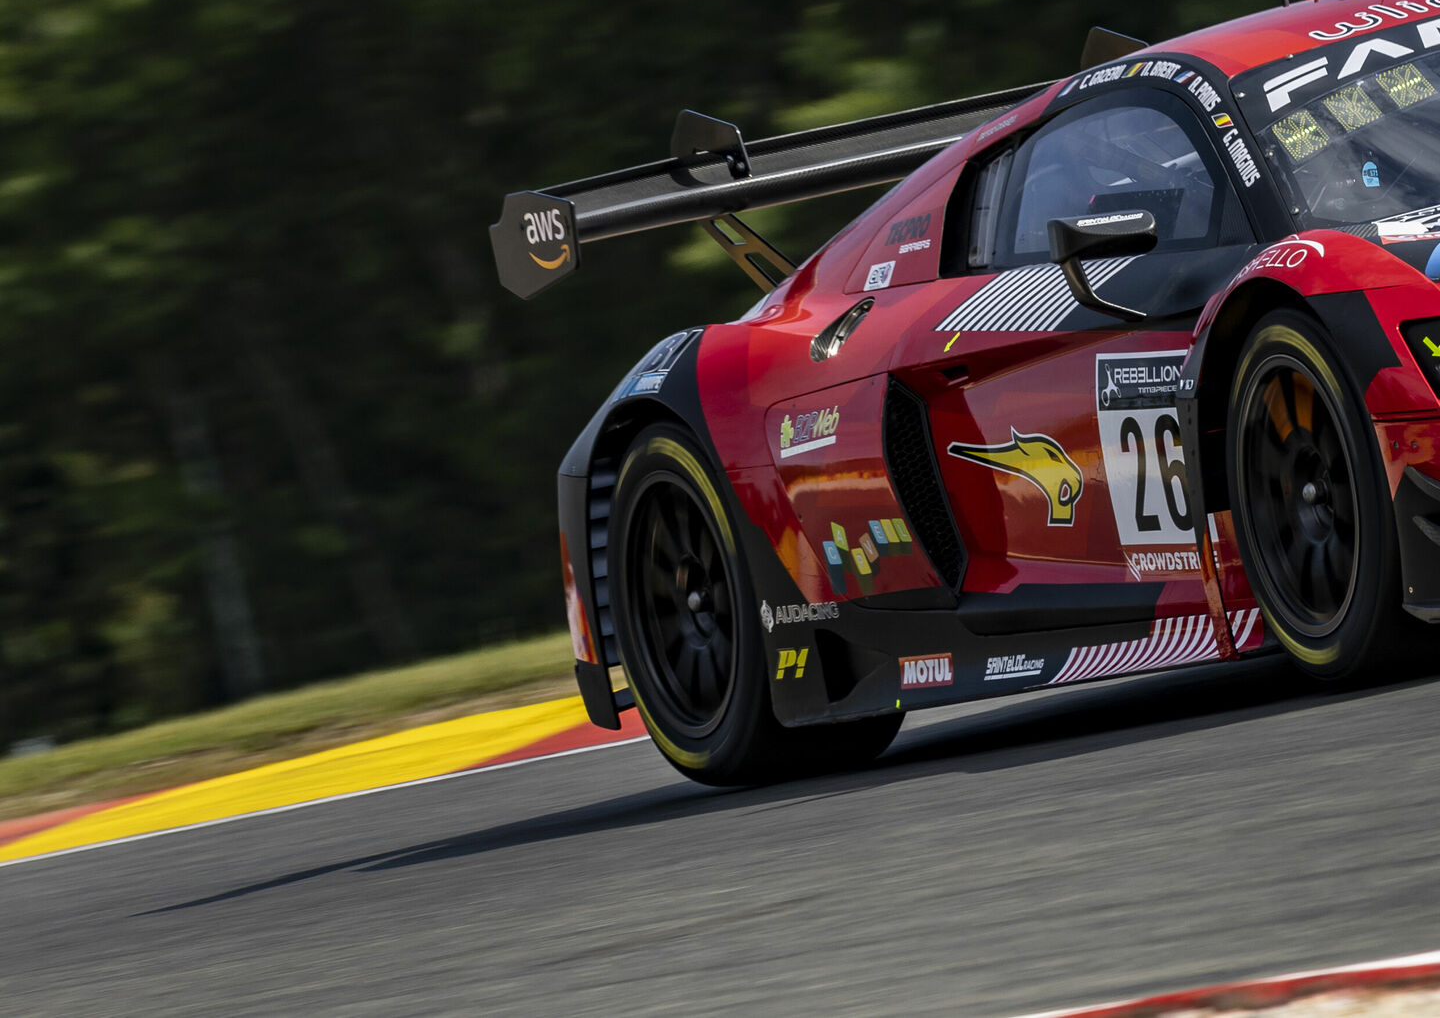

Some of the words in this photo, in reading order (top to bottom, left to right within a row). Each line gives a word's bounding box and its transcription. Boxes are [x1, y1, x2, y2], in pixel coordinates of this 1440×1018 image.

[1194, 81, 1222, 112] PANIS
[1227, 138, 1261, 188] MAGNUS
[523, 208, 565, 245] aws
[1120, 414, 1195, 532] 26
[903, 658, 952, 684] MOTUL
